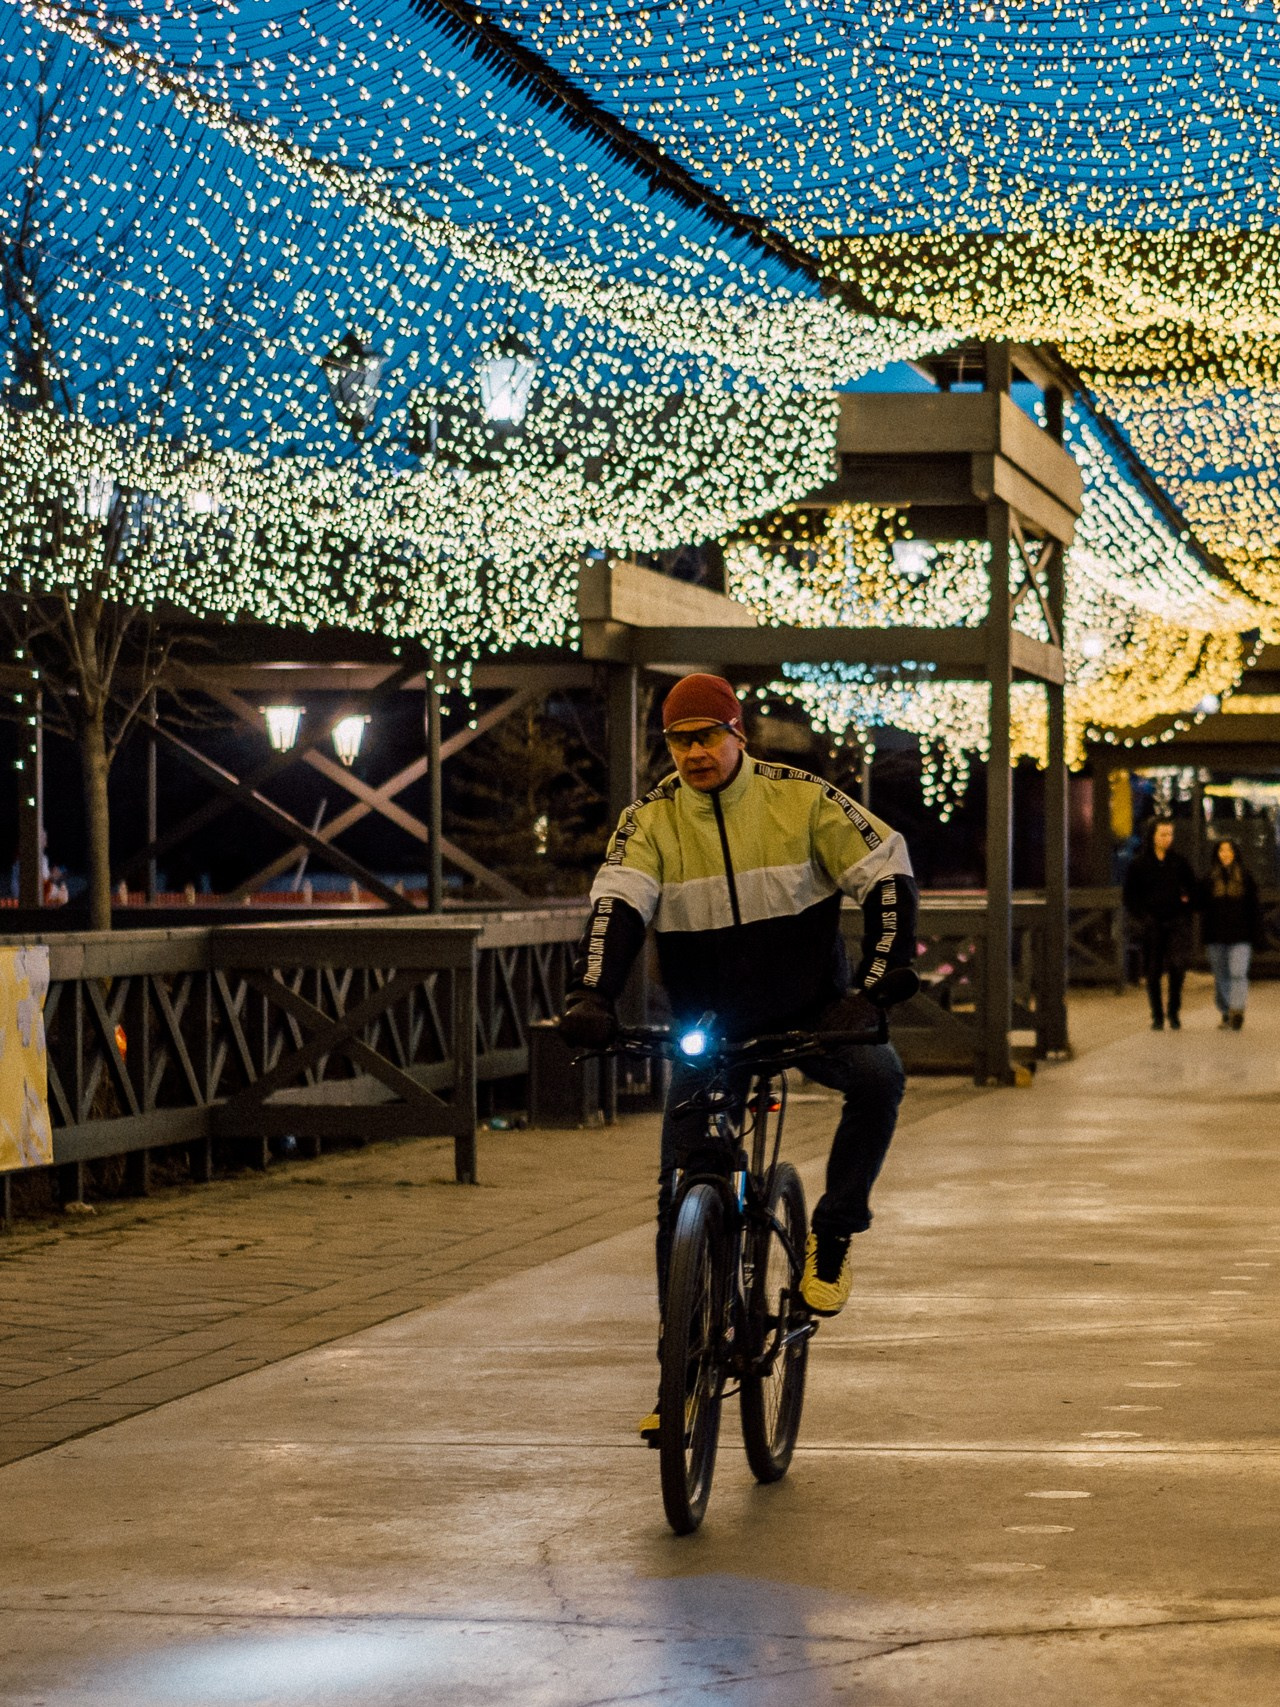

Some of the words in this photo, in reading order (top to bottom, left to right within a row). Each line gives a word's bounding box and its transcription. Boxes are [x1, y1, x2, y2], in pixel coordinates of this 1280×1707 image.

[832, 791, 849, 809] STAY
[846, 807, 868, 831] TUNED
[882, 911, 898, 931] STAY
[875, 931, 897, 953] TUNED
